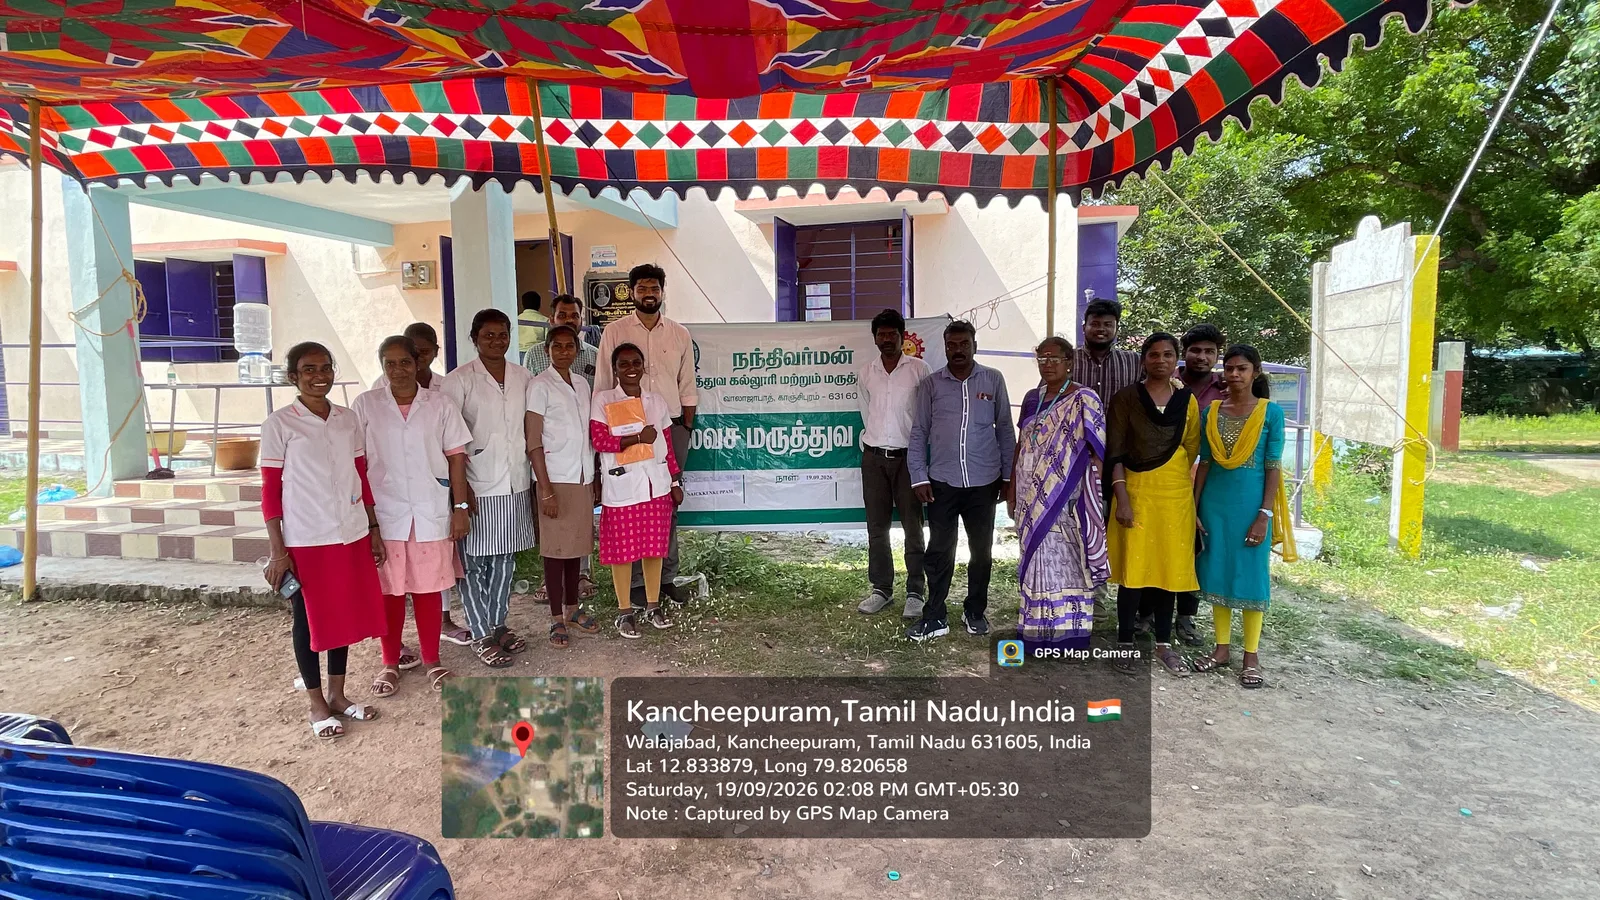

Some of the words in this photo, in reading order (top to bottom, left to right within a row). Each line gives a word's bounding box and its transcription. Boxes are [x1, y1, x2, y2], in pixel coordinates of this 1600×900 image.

[733, 345, 854, 372] நந்திவர்மன்
[779, 373, 821, 389] மற்றும்
[828, 392, 858, 401] 63160
[746, 419, 853, 458] மருத்துவ
